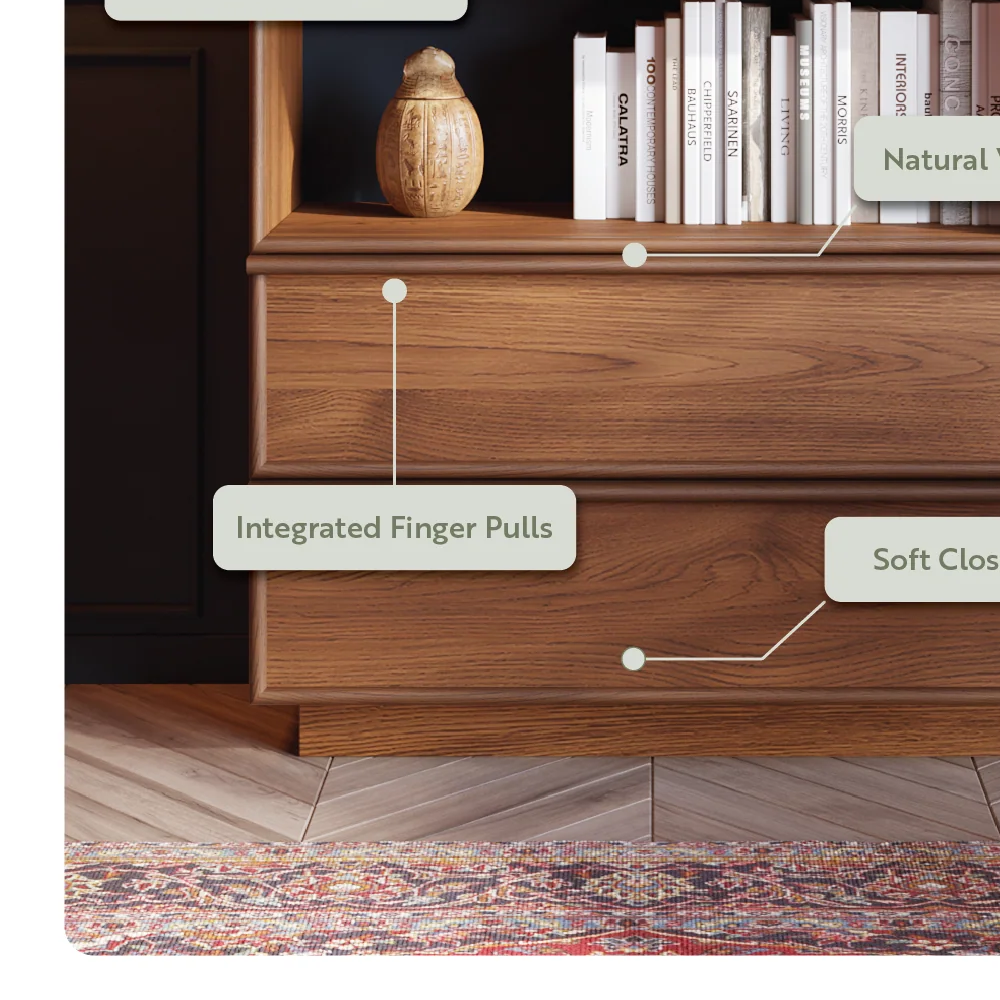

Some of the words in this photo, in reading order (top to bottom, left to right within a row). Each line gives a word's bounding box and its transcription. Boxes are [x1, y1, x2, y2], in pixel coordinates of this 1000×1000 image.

[799, 45, 810, 121] MUSEUMS
[585, 110, 593, 151] Modernism
[617, 93, 629, 167] CALATRA
[687, 88, 697, 146] BAUHAUS
[703, 80, 712, 162] CHIPPERFIELD
[728, 90, 738, 158] SAARINEN
[781, 97, 790, 156] LIVING
[837, 95, 848, 145] MORRIS
[646, 165, 656, 205] HOUSES
